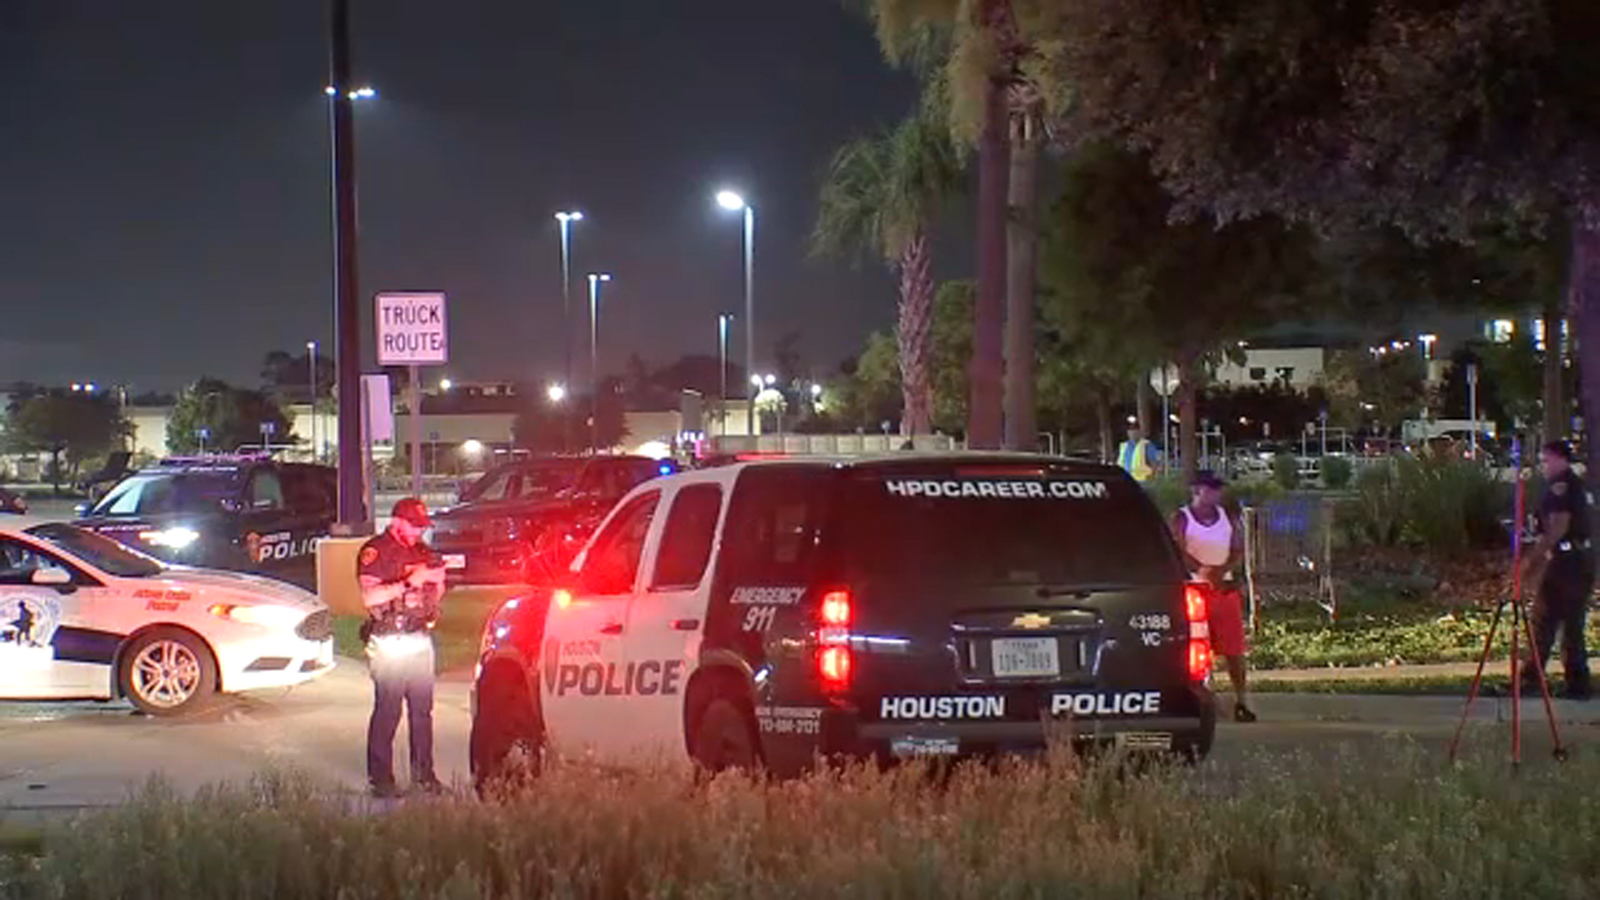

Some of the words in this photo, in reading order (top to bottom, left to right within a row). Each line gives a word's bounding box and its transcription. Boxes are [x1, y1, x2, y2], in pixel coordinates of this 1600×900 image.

[383, 304, 440, 325] TRUCK
[385, 332, 441, 352] ROUTE
[886, 480, 1108, 499] HPDCAREER.COM
[259, 537, 320, 563] POLIC
[729, 586, 807, 605] EMERGENCY
[742, 606, 777, 631] 911
[558, 659, 682, 696] POLICE
[880, 696, 1005, 719] HOUSTON
[1051, 692, 1161, 715] POLICE
